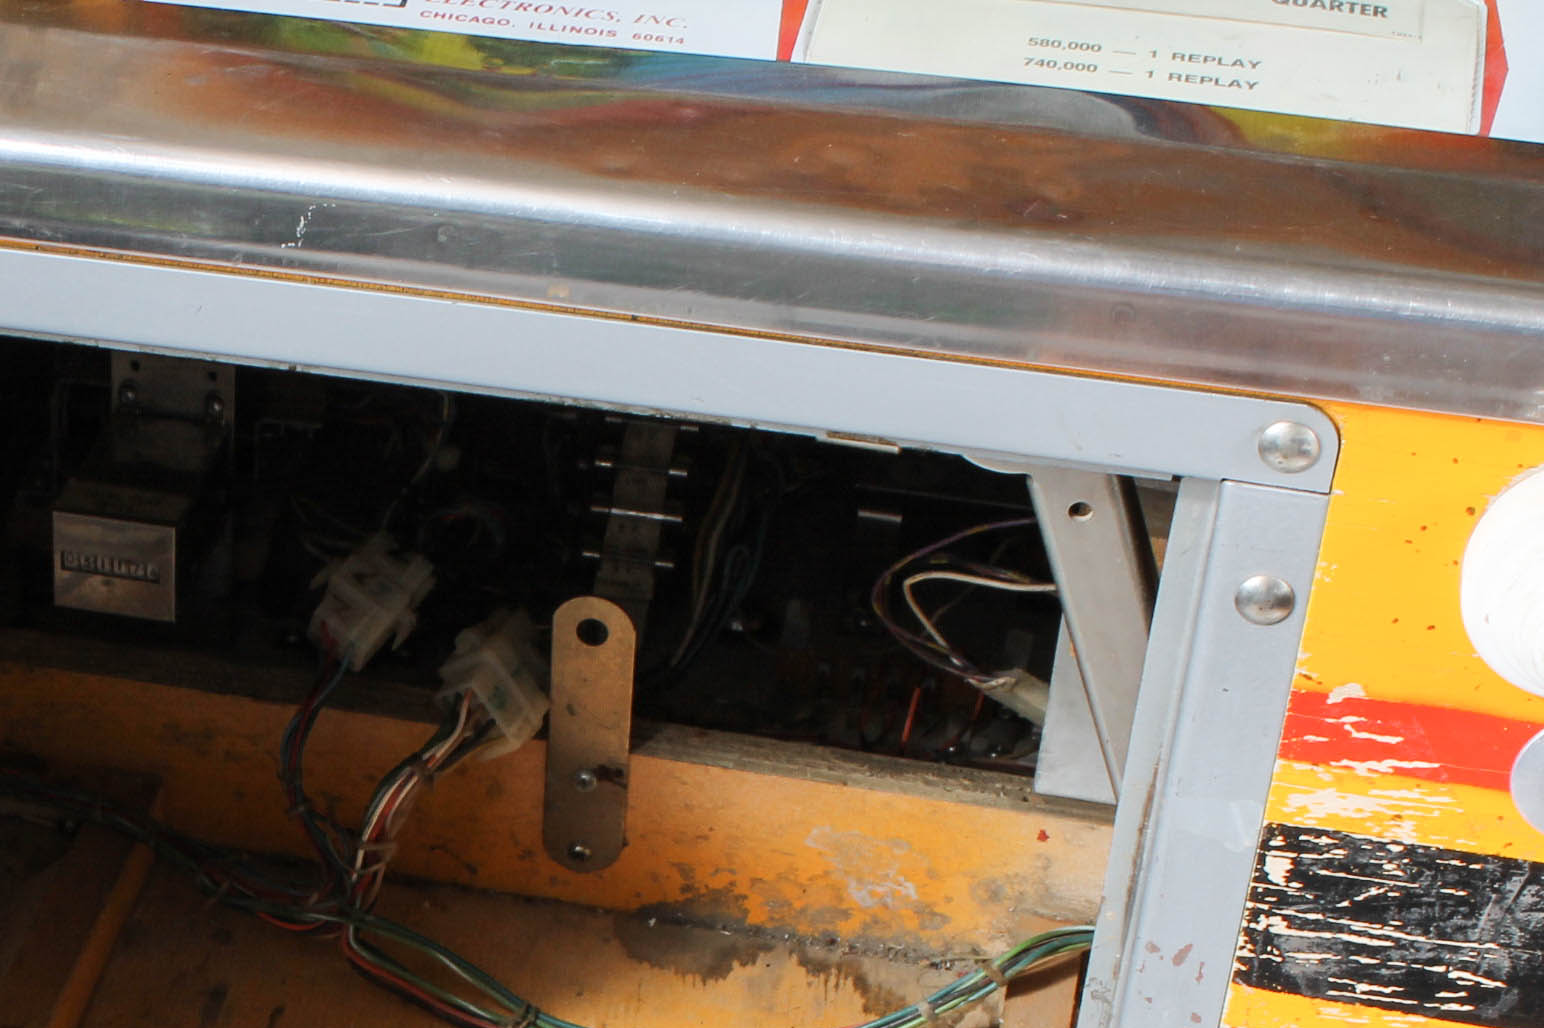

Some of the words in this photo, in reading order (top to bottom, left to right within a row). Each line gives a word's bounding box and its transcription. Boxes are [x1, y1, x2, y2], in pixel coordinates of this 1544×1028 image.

[633, 14, 687, 29] INC.
[529, 21, 617, 38] ILLINOIS
[632, 33, 685, 45] 60614
[1148, 49, 1157, 58] 1
[1172, 52, 1262, 69] REPLAY
[1146, 70, 1154, 79] 1
[1168, 72, 1259, 90] REPLAY
